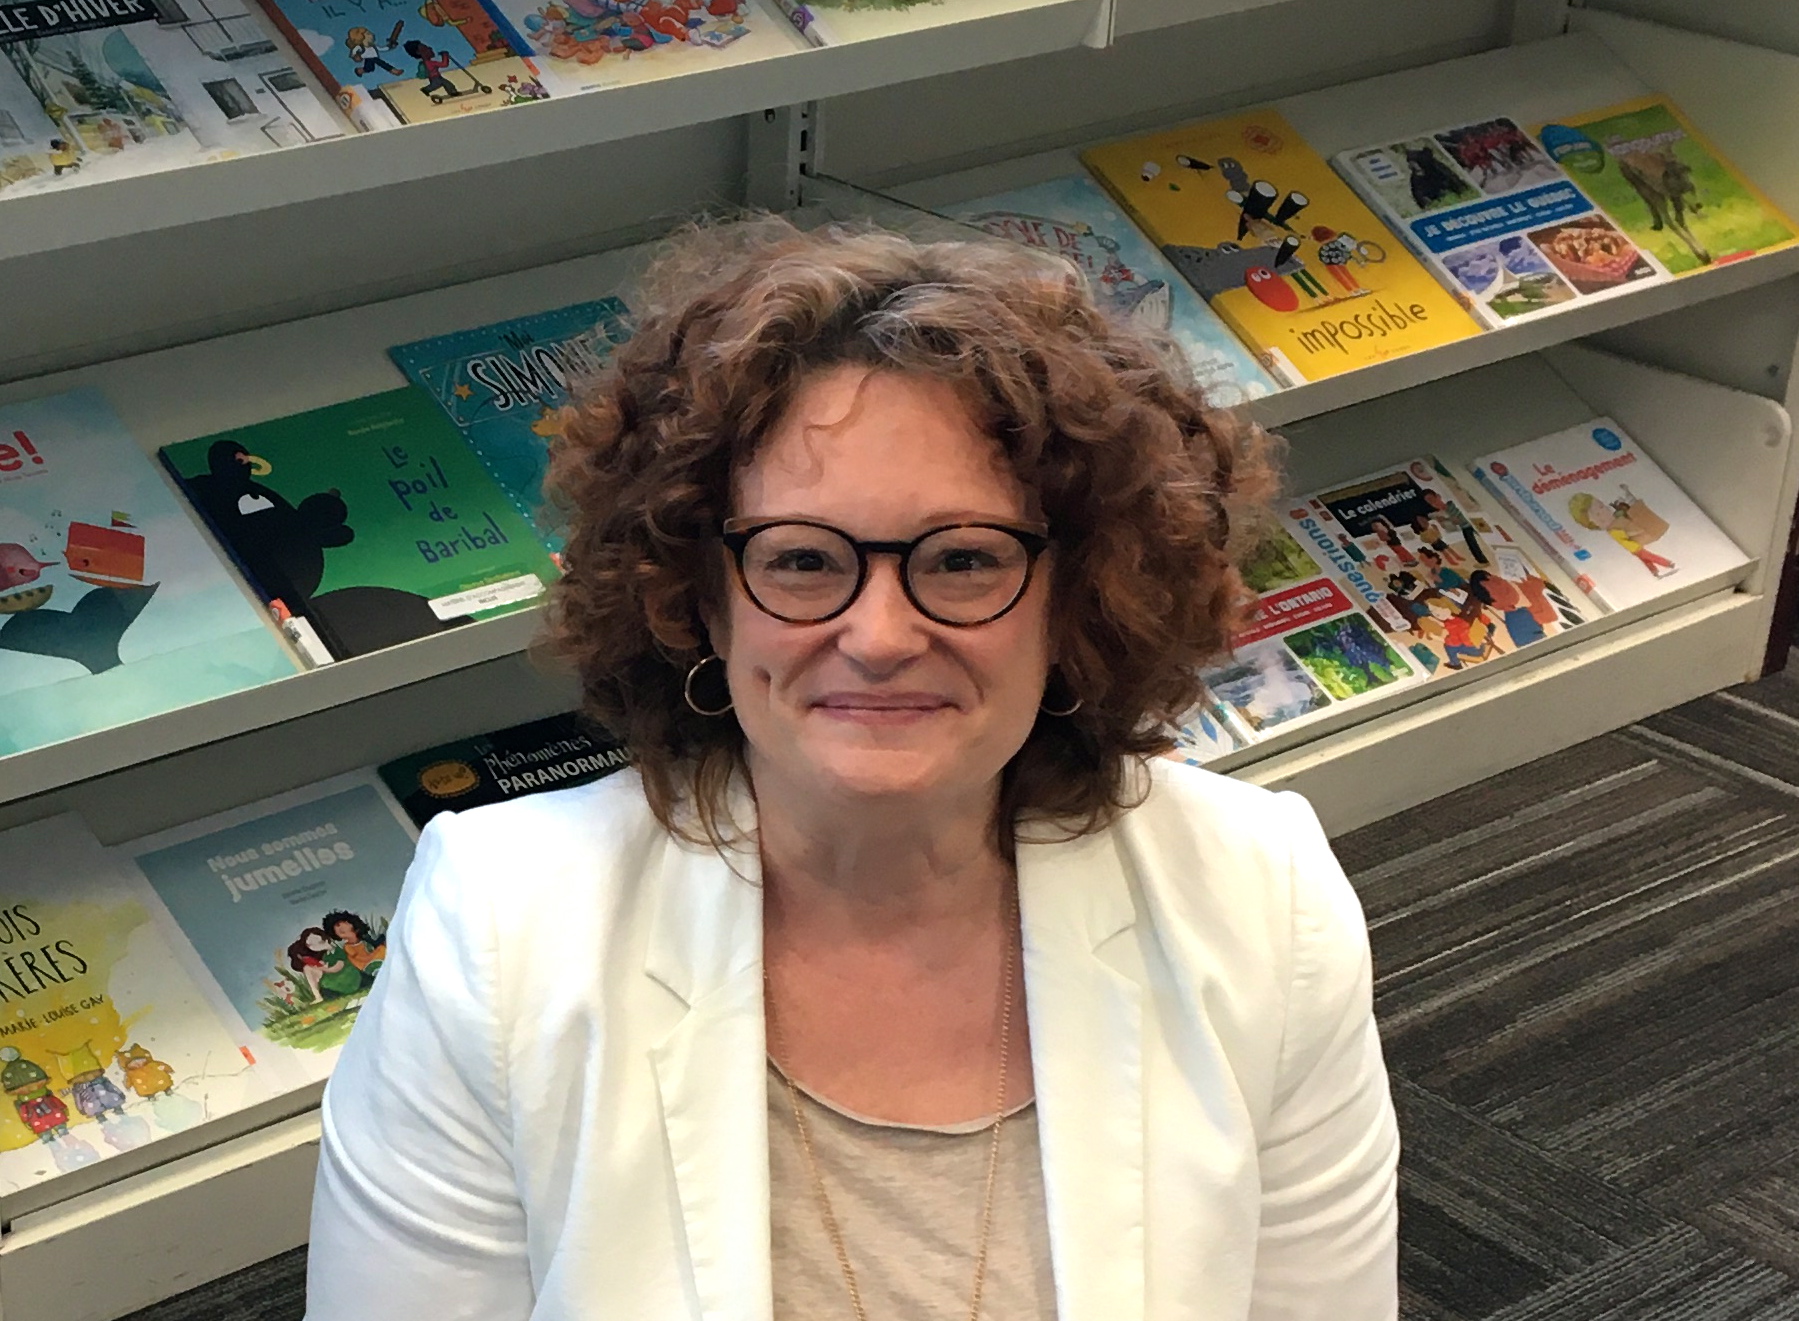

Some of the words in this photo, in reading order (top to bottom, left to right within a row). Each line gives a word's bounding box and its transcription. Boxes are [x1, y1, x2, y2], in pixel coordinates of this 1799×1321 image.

[0, 8, 38, 34] LE
[1289, 299, 1428, 355] impossible
[381, 446, 408, 468] Le
[1532, 462, 1555, 476] Le
[429, 501, 458, 522] de
[1338, 508, 1357, 520] Le
[1356, 488, 1417, 514] calendrier
[416, 511, 509, 564] Baribal
[1268, 586, 1333, 615] L'ONTARIO
[206, 848, 260, 872] Nous
[261, 822, 338, 856] sommes
[221, 841, 355, 903] jumelles
[80, 994, 104, 1010] GAY
